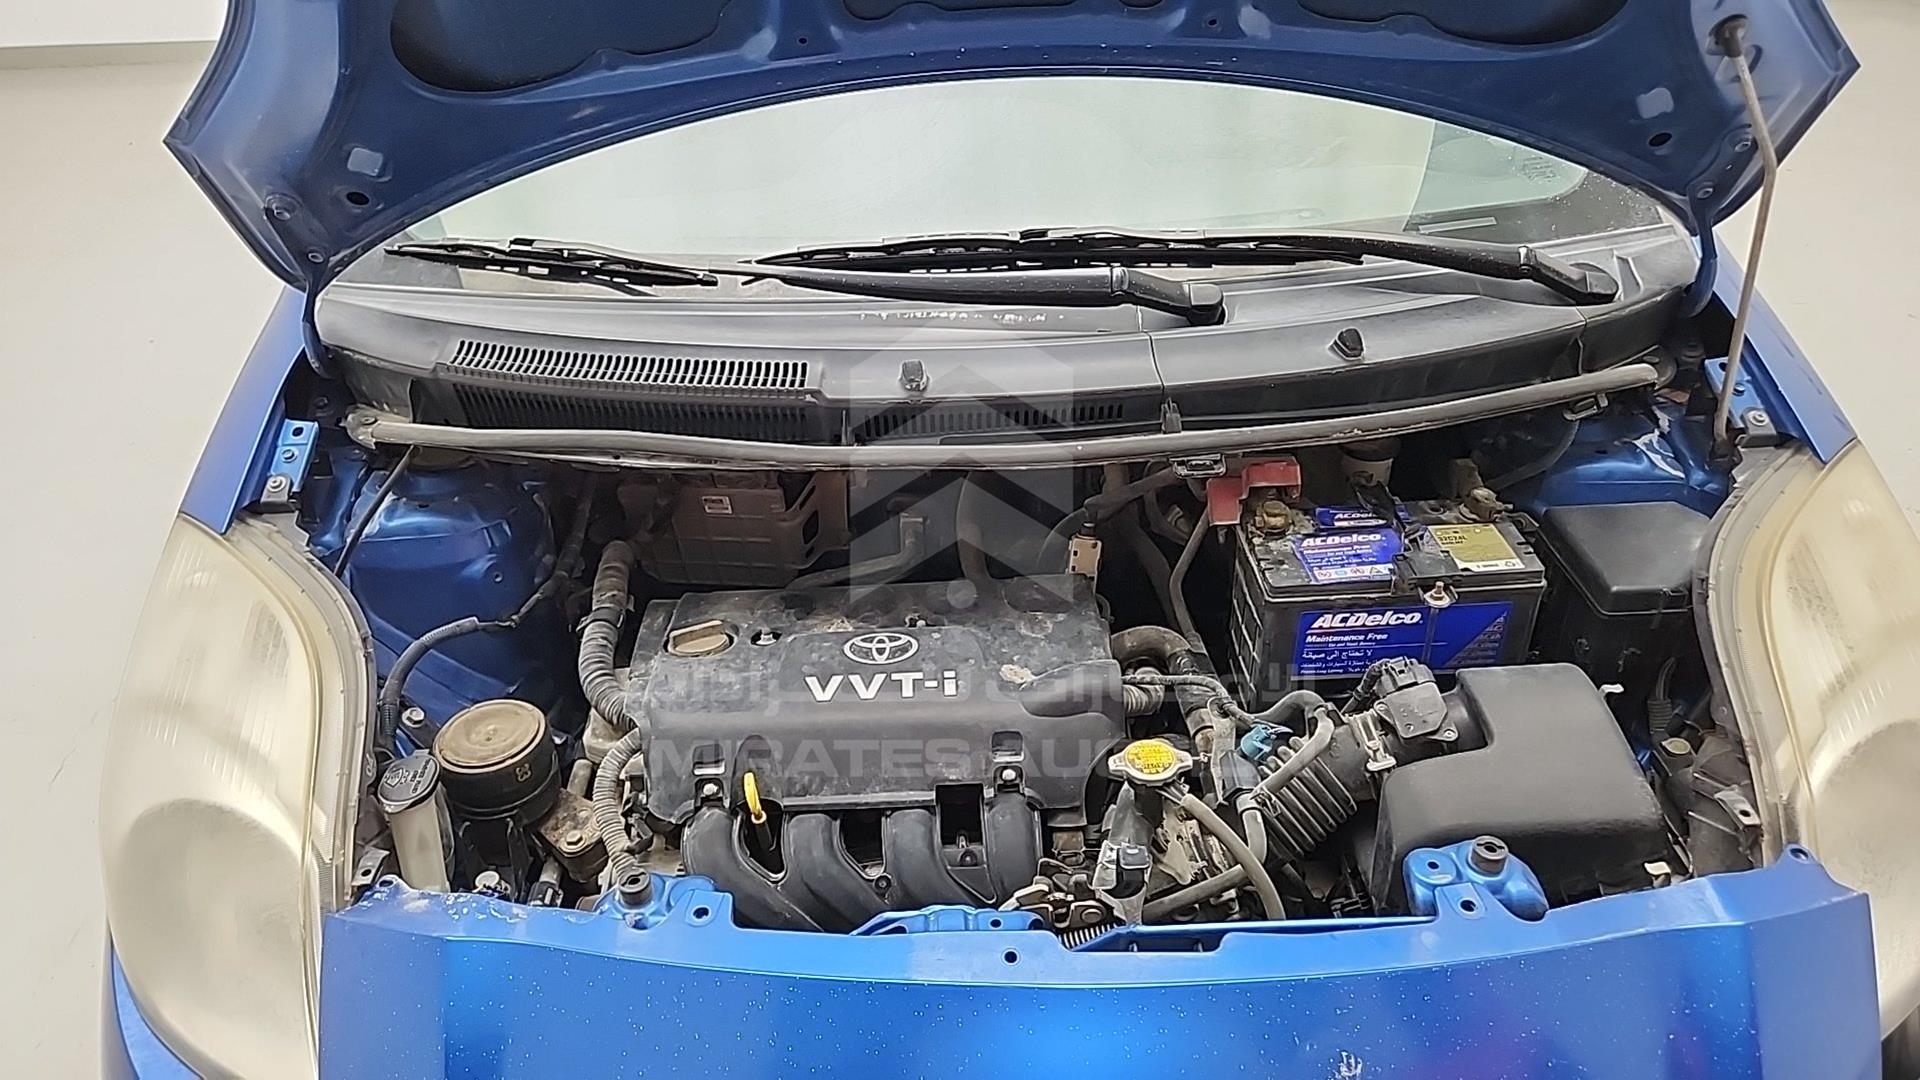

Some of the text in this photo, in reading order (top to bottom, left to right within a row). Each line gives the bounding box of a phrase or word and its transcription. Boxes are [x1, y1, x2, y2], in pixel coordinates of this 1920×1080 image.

[1301, 533, 1382, 547] ACDelco
[1310, 611, 1422, 629] ACDelco
[1305, 632, 1388, 643] Maintenance Free
[804, 670, 957, 702] VVT-i
